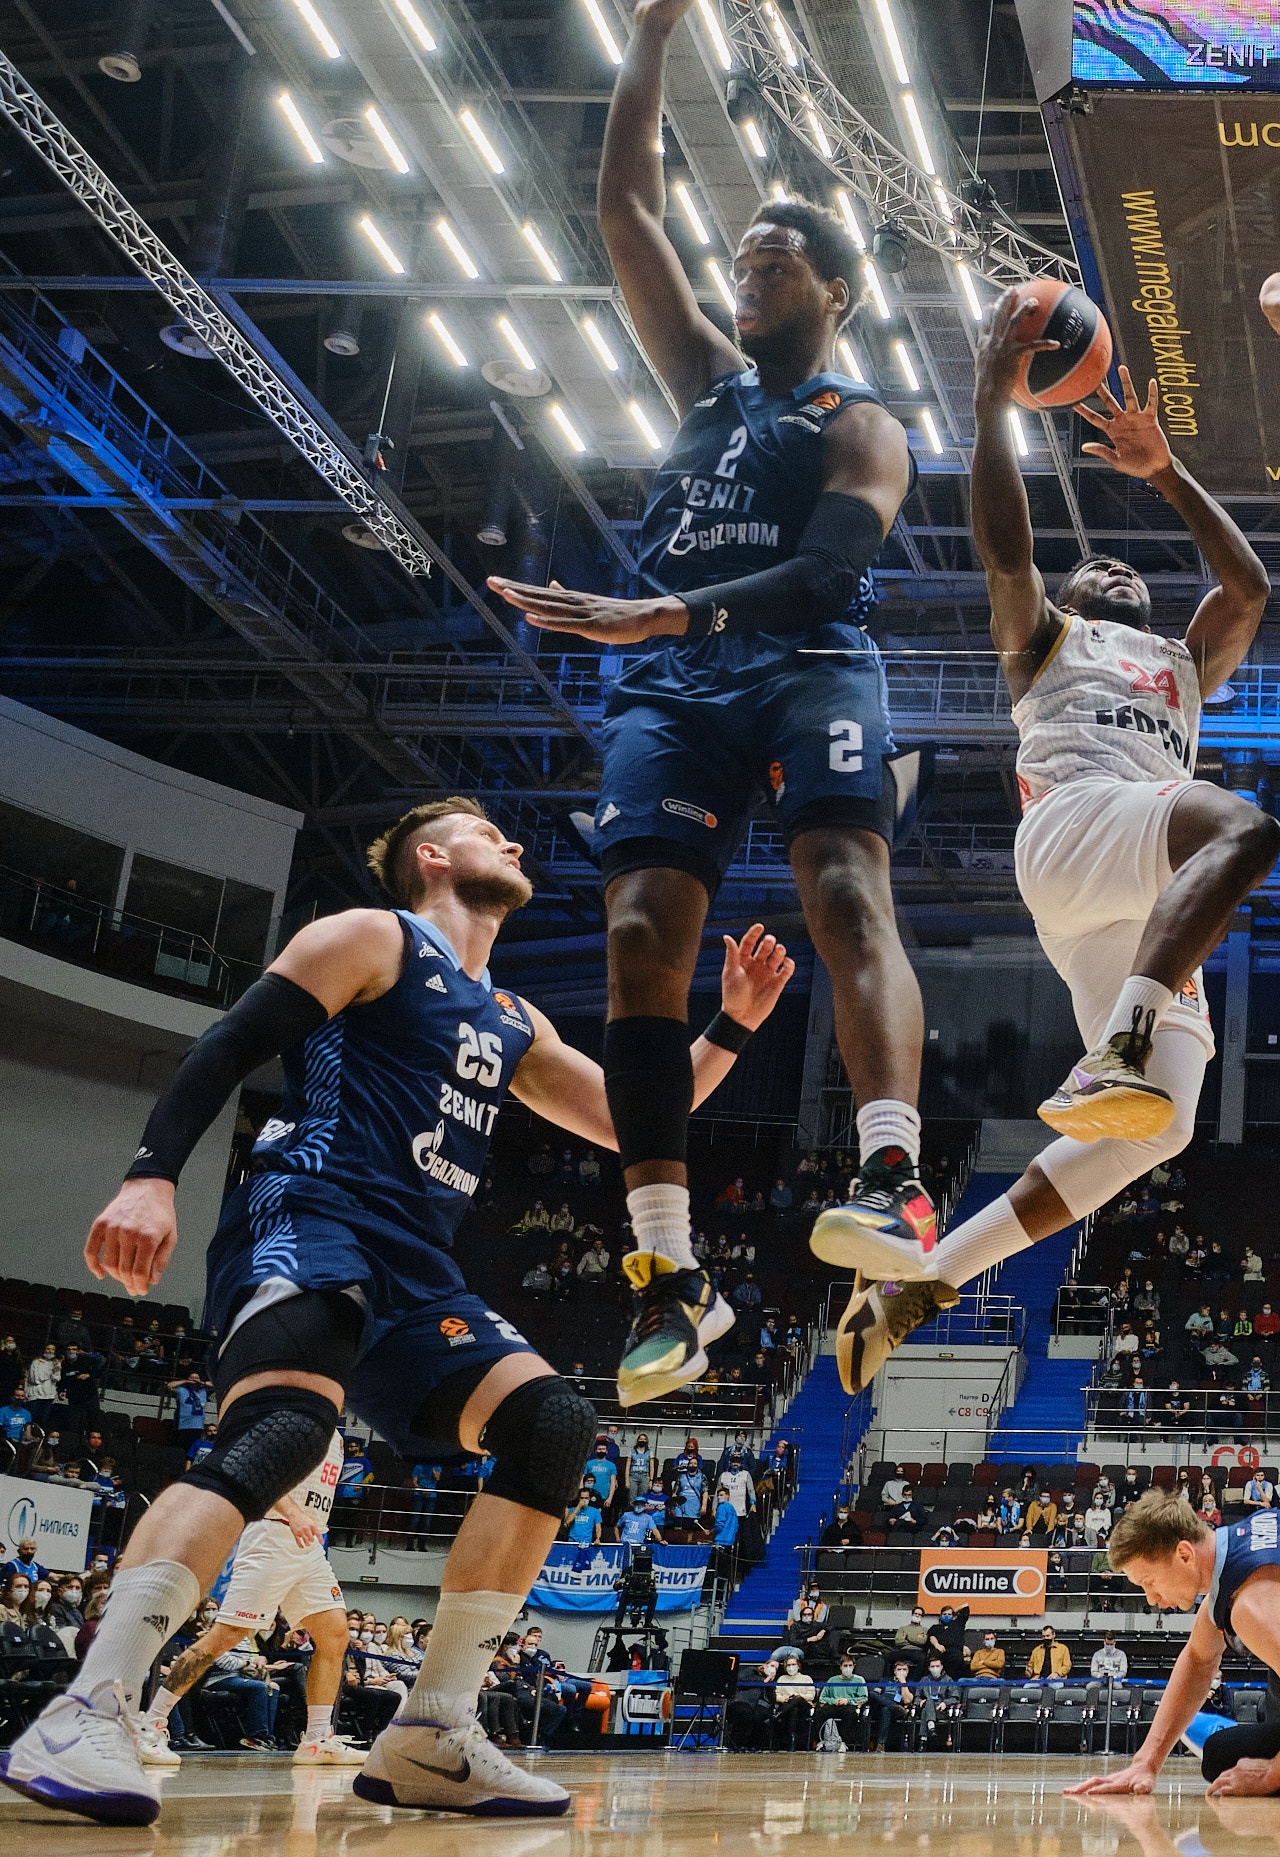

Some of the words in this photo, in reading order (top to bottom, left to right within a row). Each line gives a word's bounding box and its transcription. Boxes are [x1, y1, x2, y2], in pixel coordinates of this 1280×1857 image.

[1186, 43, 1275, 68] ZENIT
[1121, 190, 1200, 436] www.megaluxltd.com
[715, 424, 748, 480] 2
[1118, 659, 1182, 713] 24
[829, 719, 864, 773] 2
[456, 1022, 503, 1088] 25
[439, 1083, 500, 1137] ZENIT
[981, 1393, 989, 1403] D
[958, 1407, 971, 1417] C8
[320, 1462, 340, 1487] 55
[39, 1518, 79, 1538] НИПИГАЗ
[536, 1569, 582, 1587] АШЕ
[586, 1573, 621, 1587] ИМ
[654, 1571, 700, 1586] ЕНИТ
[932, 1572, 1009, 1590] Winline
